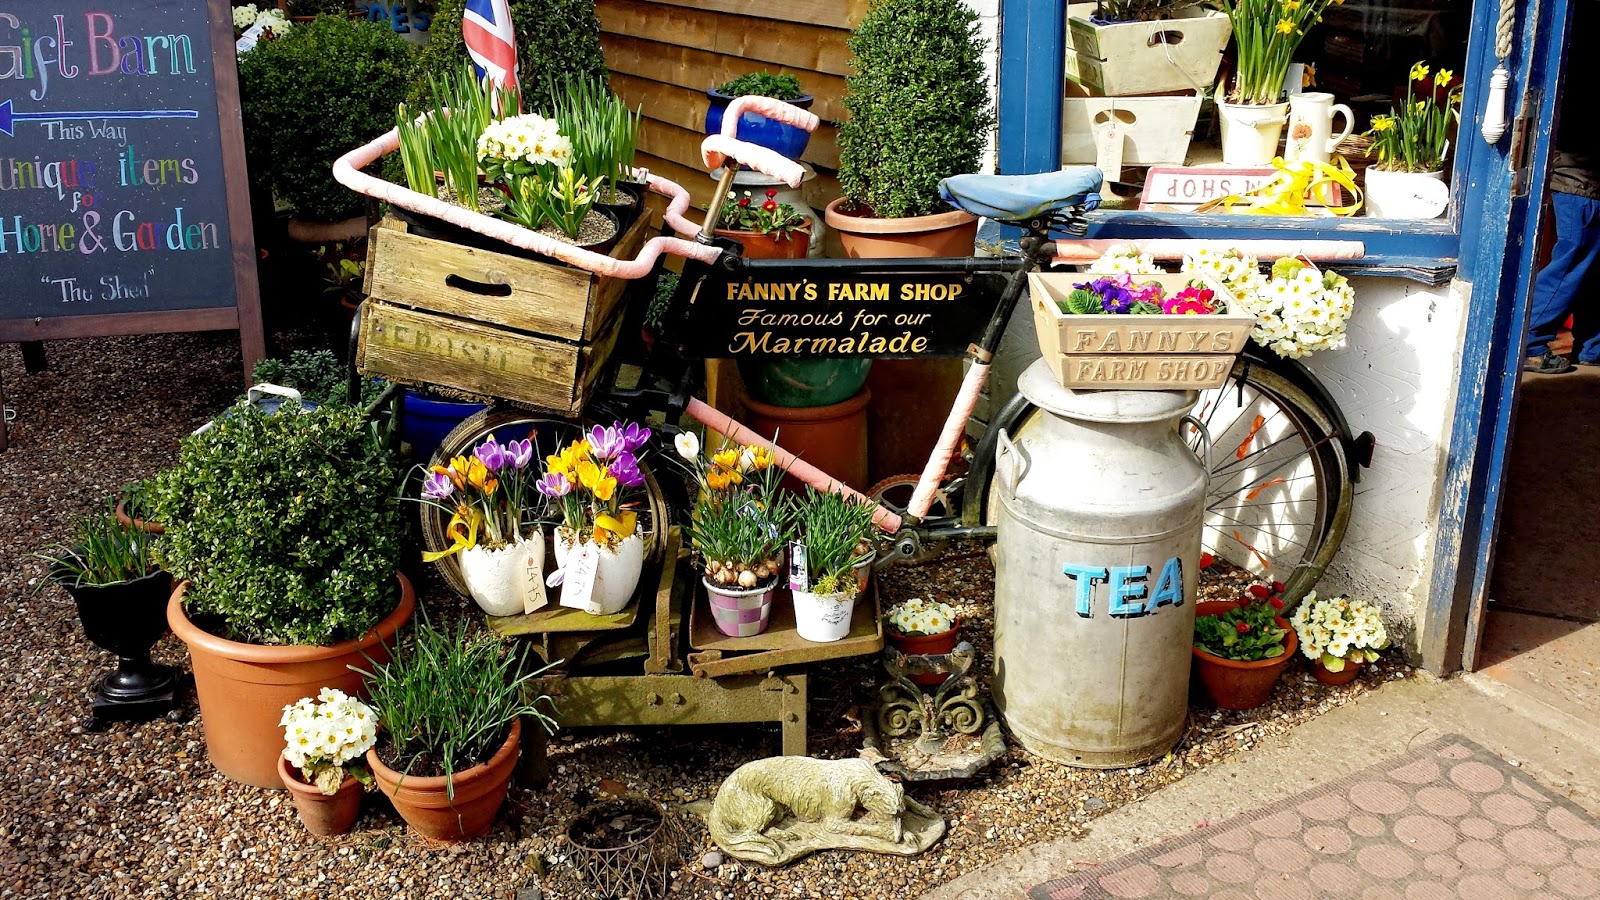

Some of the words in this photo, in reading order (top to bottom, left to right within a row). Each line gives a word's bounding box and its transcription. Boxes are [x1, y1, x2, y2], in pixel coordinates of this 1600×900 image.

[0, 12, 79, 101] Gift
[84, 11, 197, 75] Barn
[41, 120, 84, 140] This
[87, 117, 127, 148] Way
[118, 144, 199, 187] items
[70, 191, 103, 213] for
[0, 215, 75, 254] Home
[78, 210, 108, 255] &
[112, 207, 220, 252] Garden
[727, 278, 818, 301] FANNY'S
[828, 283, 890, 301] FARM
[900, 284, 963, 301] SHOP
[737, 308, 844, 326] Famous
[850, 308, 888, 331] for
[894, 313, 931, 326] our
[728, 332, 928, 354] Marmalade
[1073, 330, 1233, 351] FANNYS
[1075, 360, 1148, 381] FARM
[1156, 359, 1227, 381] SHOP
[1062, 557, 1184, 619] TEA
